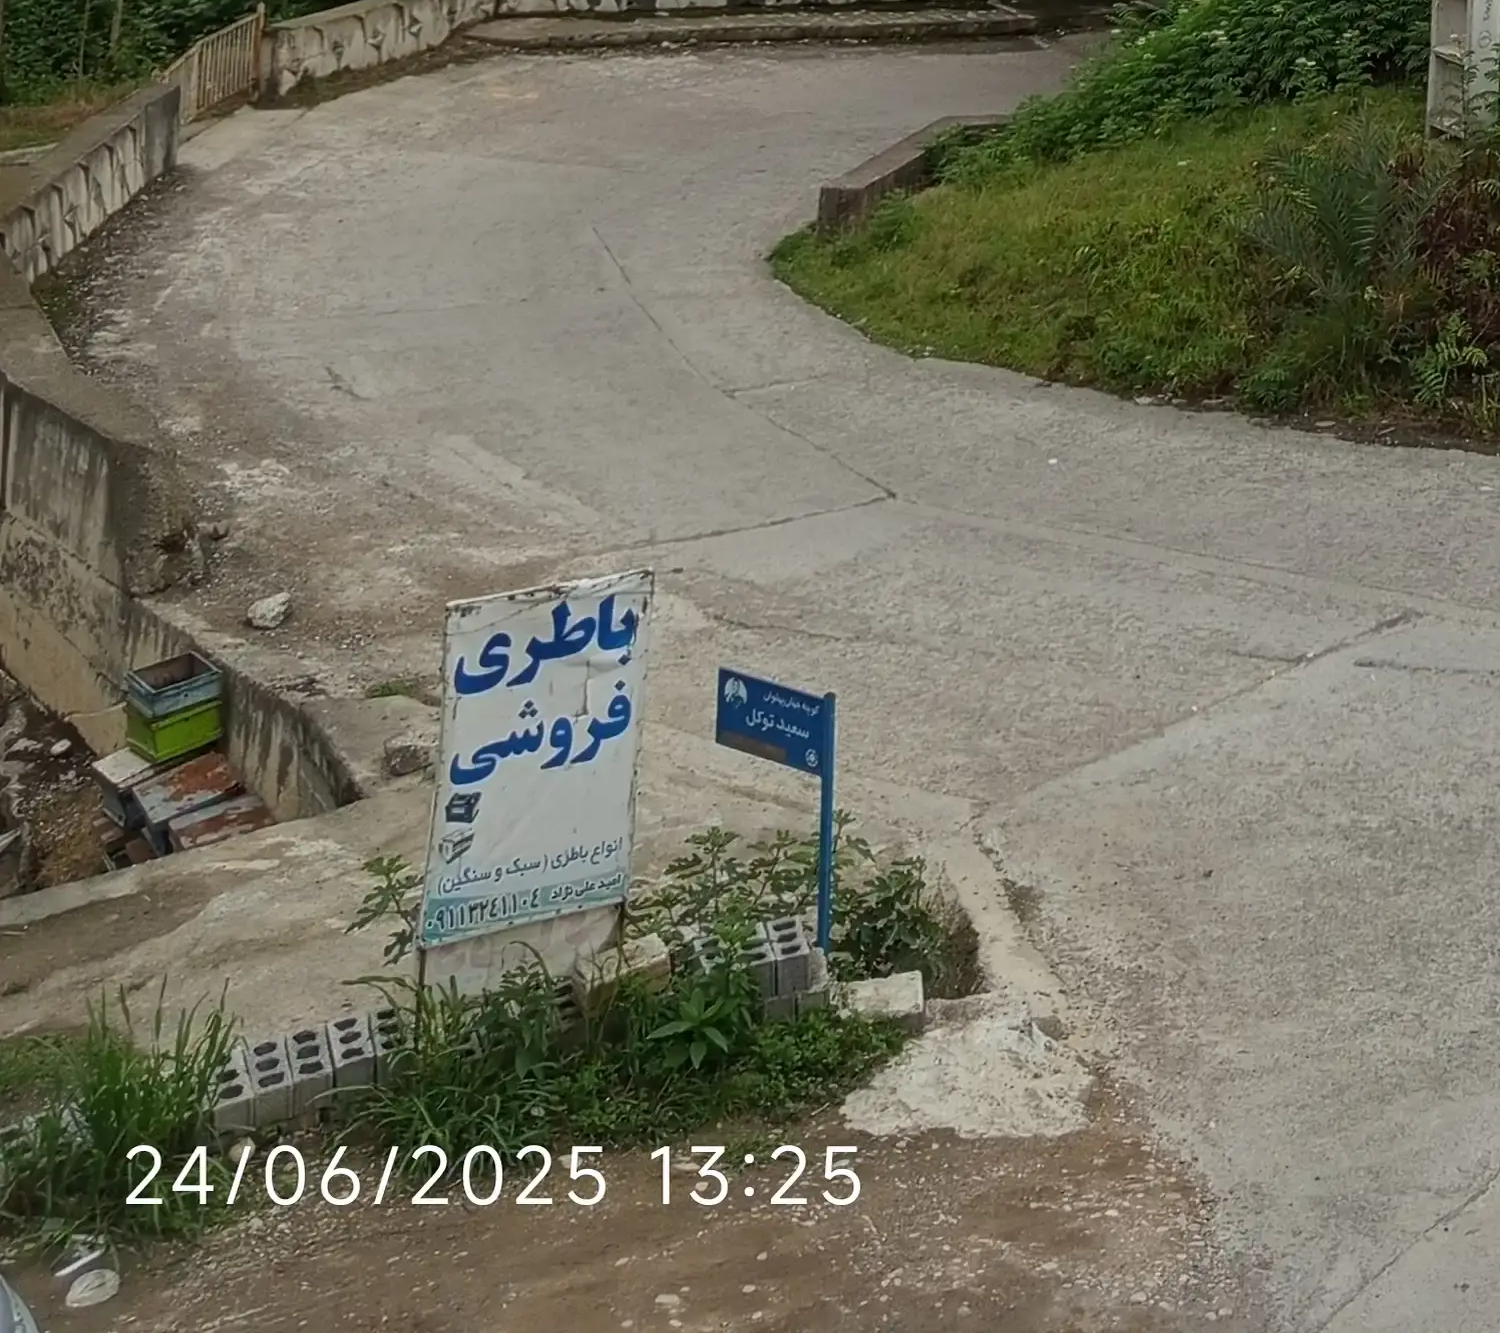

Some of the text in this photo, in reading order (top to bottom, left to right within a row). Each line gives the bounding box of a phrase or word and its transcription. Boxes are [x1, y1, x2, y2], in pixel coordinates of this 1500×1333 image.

[454, 594, 635, 695] باطری
[450, 680, 632, 785] فروشی
[745, 708, 810, 739] سعید توکل
[590, 836, 624, 864] انواع
[494, 866, 503, 882] و
[598, 874, 621, 890] امید
[551, 884, 573, 900] نژاد
[575, 881, 595, 897] علی
